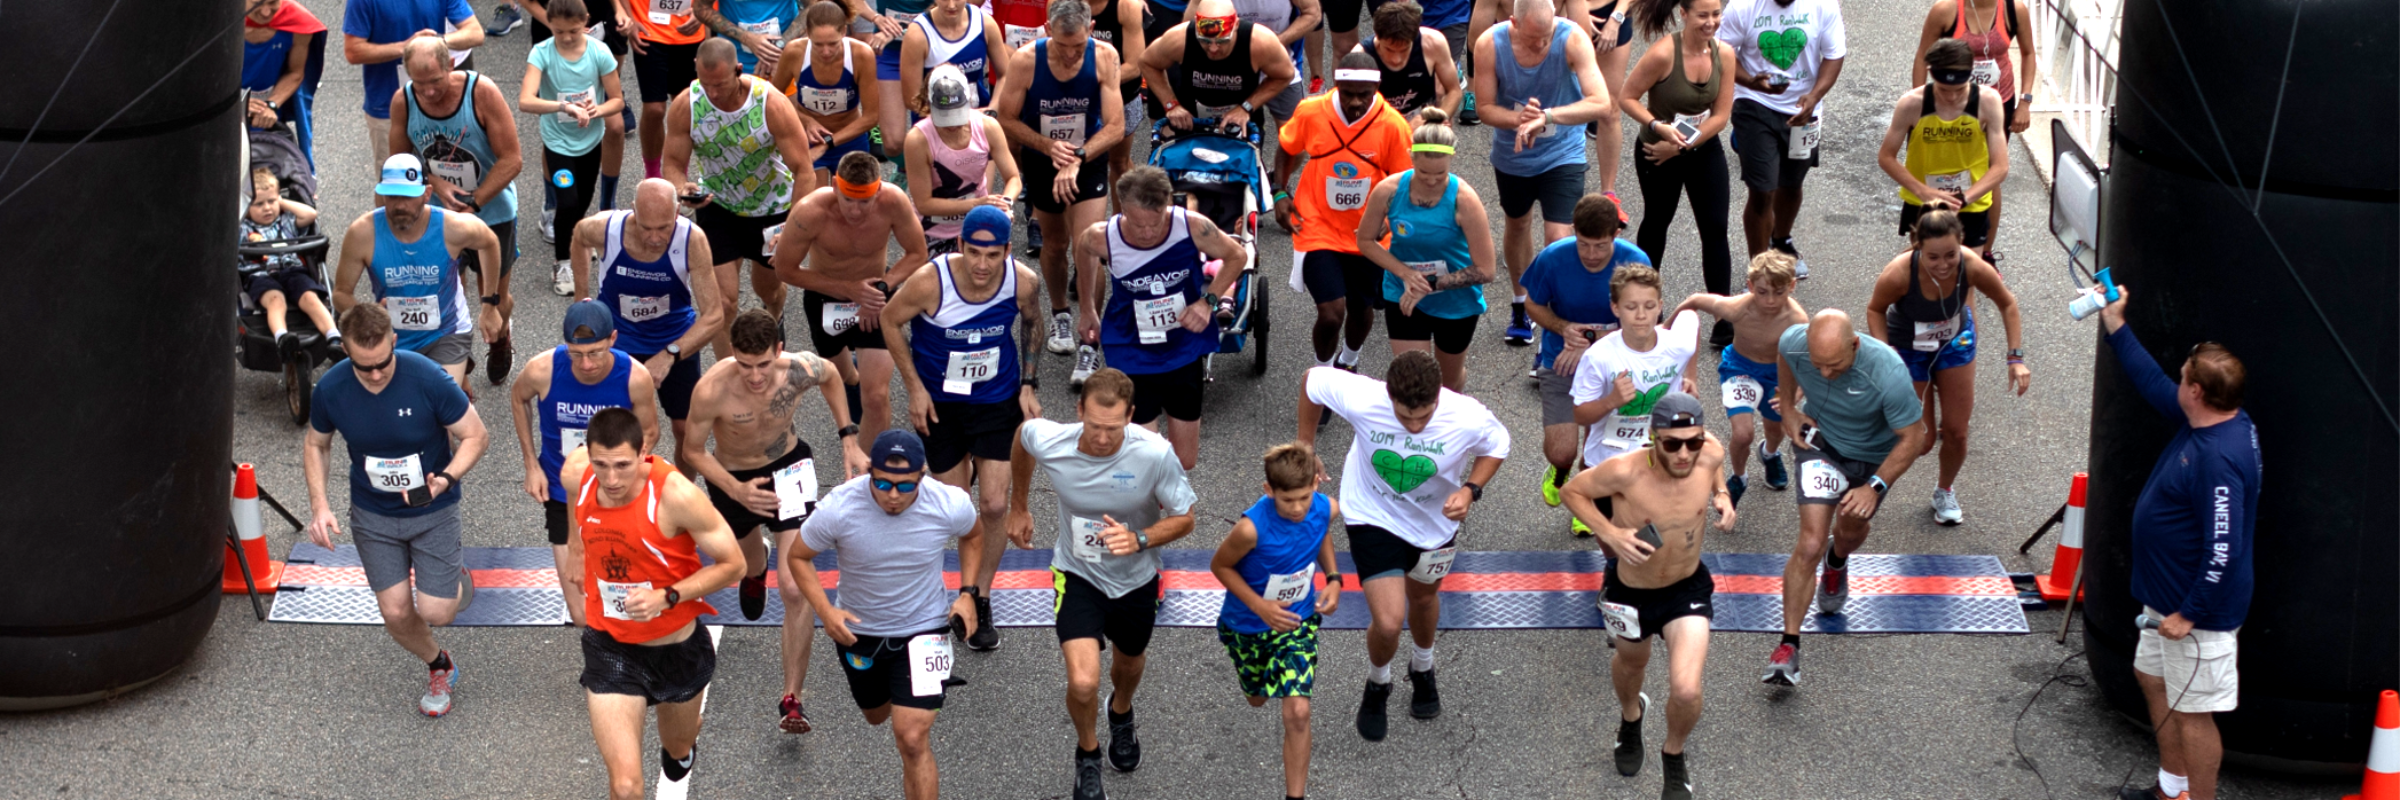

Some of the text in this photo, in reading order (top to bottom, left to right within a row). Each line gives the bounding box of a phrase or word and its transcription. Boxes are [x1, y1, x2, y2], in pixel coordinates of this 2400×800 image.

[659, 0, 682, 11] 637
[1090, 29, 1113, 39] NING
[1193, 70, 1242, 84] RUNNING
[813, 100, 837, 111] 112
[1040, 97, 1089, 109] RUNNING
[1050, 128, 1075, 140] 657
[1922, 126, 1973, 137] RUNNING
[1335, 193, 1361, 205] 666
[384, 265, 440, 277] RUNNING
[400, 311, 428, 325] 240
[631, 305, 658, 318] 684
[1149, 311, 1177, 327] 113
[945, 324, 1005, 336] ENDEAVOR
[1926, 328, 1953, 340] 703
[961, 364, 988, 378] 110
[1733, 387, 1757, 402] 339
[1370, 430, 1395, 446] 2019
[1616, 427, 1645, 439] 674
[380, 473, 411, 487] 305
[795, 480, 804, 494] 1
[1813, 475, 1839, 492] 340
[1084, 534, 1105, 548] 24
[2204, 486, 2230, 584] CANEEL BAY, VI
[1426, 560, 1453, 575] 757
[1277, 584, 1306, 601] 597
[925, 654, 950, 672] 503
